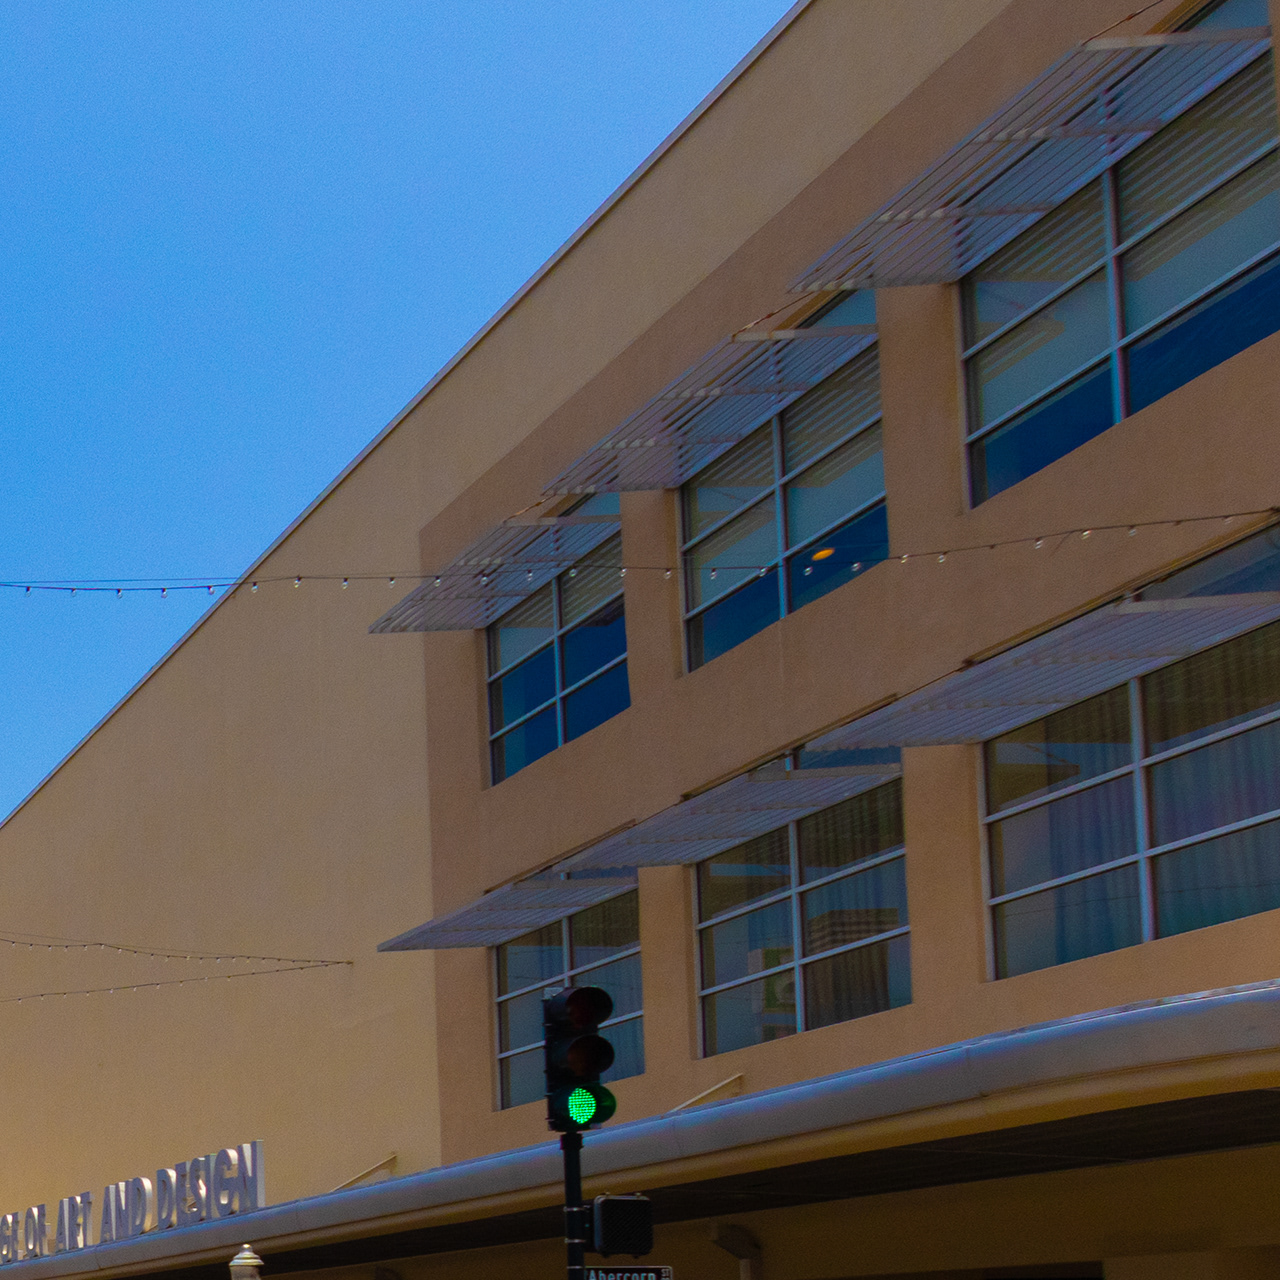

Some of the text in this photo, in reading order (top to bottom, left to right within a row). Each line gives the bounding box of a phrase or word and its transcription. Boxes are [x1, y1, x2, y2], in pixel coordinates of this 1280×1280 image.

[25, 1204, 51, 1258] OF
[56, 1191, 94, 1251] ART
[100, 1177, 153, 1243] AND
[156, 1139, 265, 1229] DESIGN
